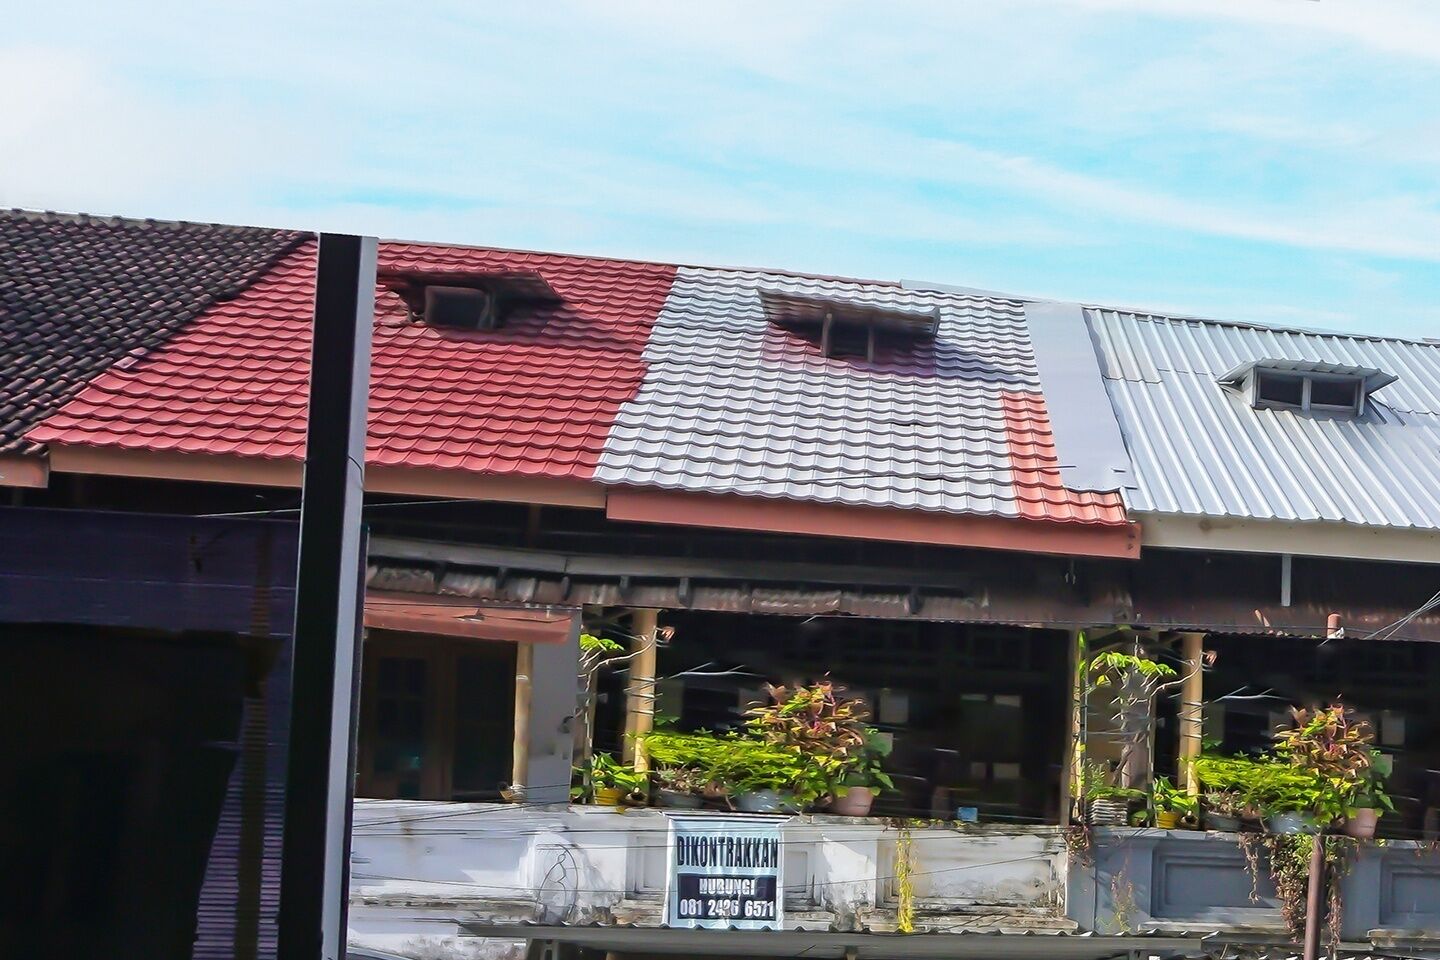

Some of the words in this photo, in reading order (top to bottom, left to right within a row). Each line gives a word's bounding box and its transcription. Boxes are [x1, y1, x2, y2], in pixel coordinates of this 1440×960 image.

[677, 835, 778, 868] DIKONTRAKKAN
[699, 878, 755, 896] HUBUNGI
[680, 898, 702, 916] 081
[744, 900, 774, 917] 6571
